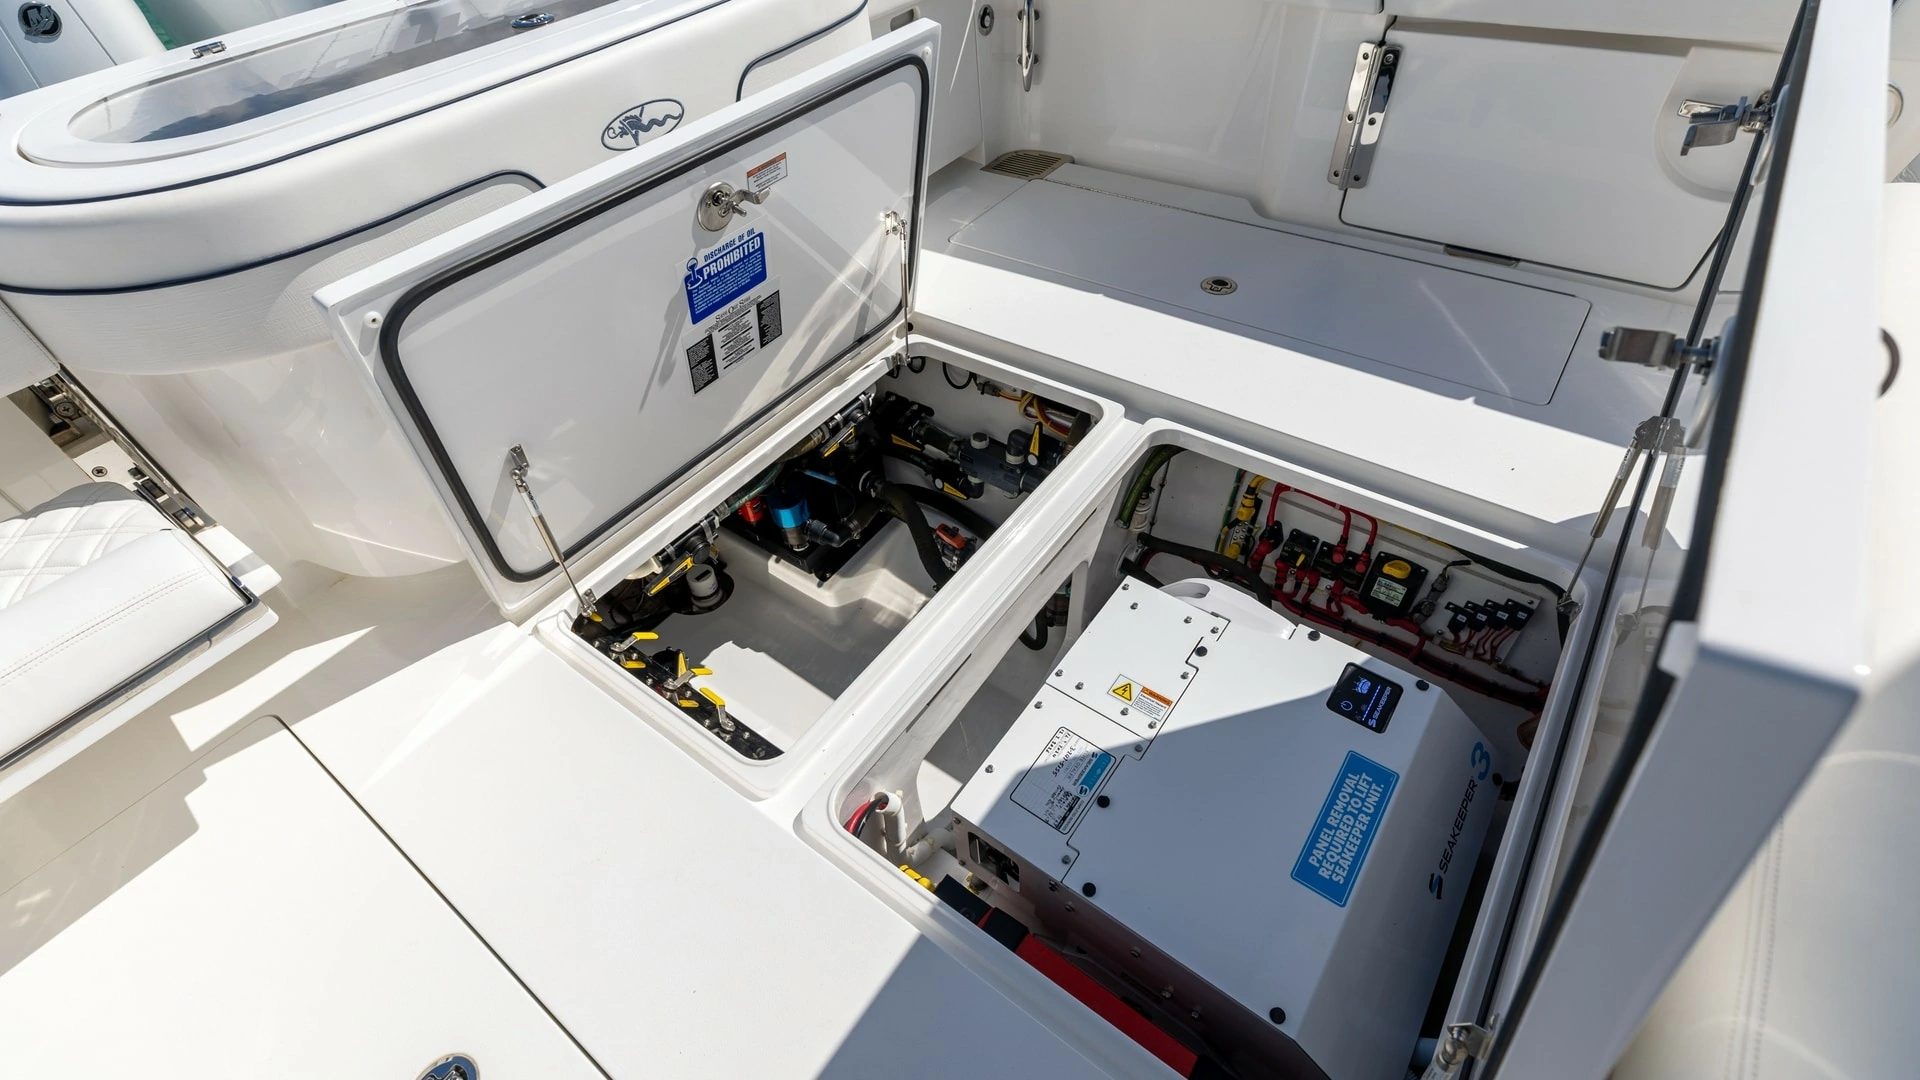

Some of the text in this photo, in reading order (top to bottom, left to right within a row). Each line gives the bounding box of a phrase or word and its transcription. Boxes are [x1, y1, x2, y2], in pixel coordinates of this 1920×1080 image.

[702, 236, 760, 280] PROHIBITED
[704, 228, 756, 262] DISCHARGE OF OIL
[1372, 686, 1392, 719] SEAKEEPER
[1072, 758, 1093, 786] SEAKEEPER
[1308, 773, 1360, 868] PANEL REMOVAL
[1318, 772, 1373, 879] REQUIRED TO LIFT
[1332, 783, 1384, 884] SEAKEEPER UNIT.
[1439, 741, 1490, 874] SEAKEEPER 3
